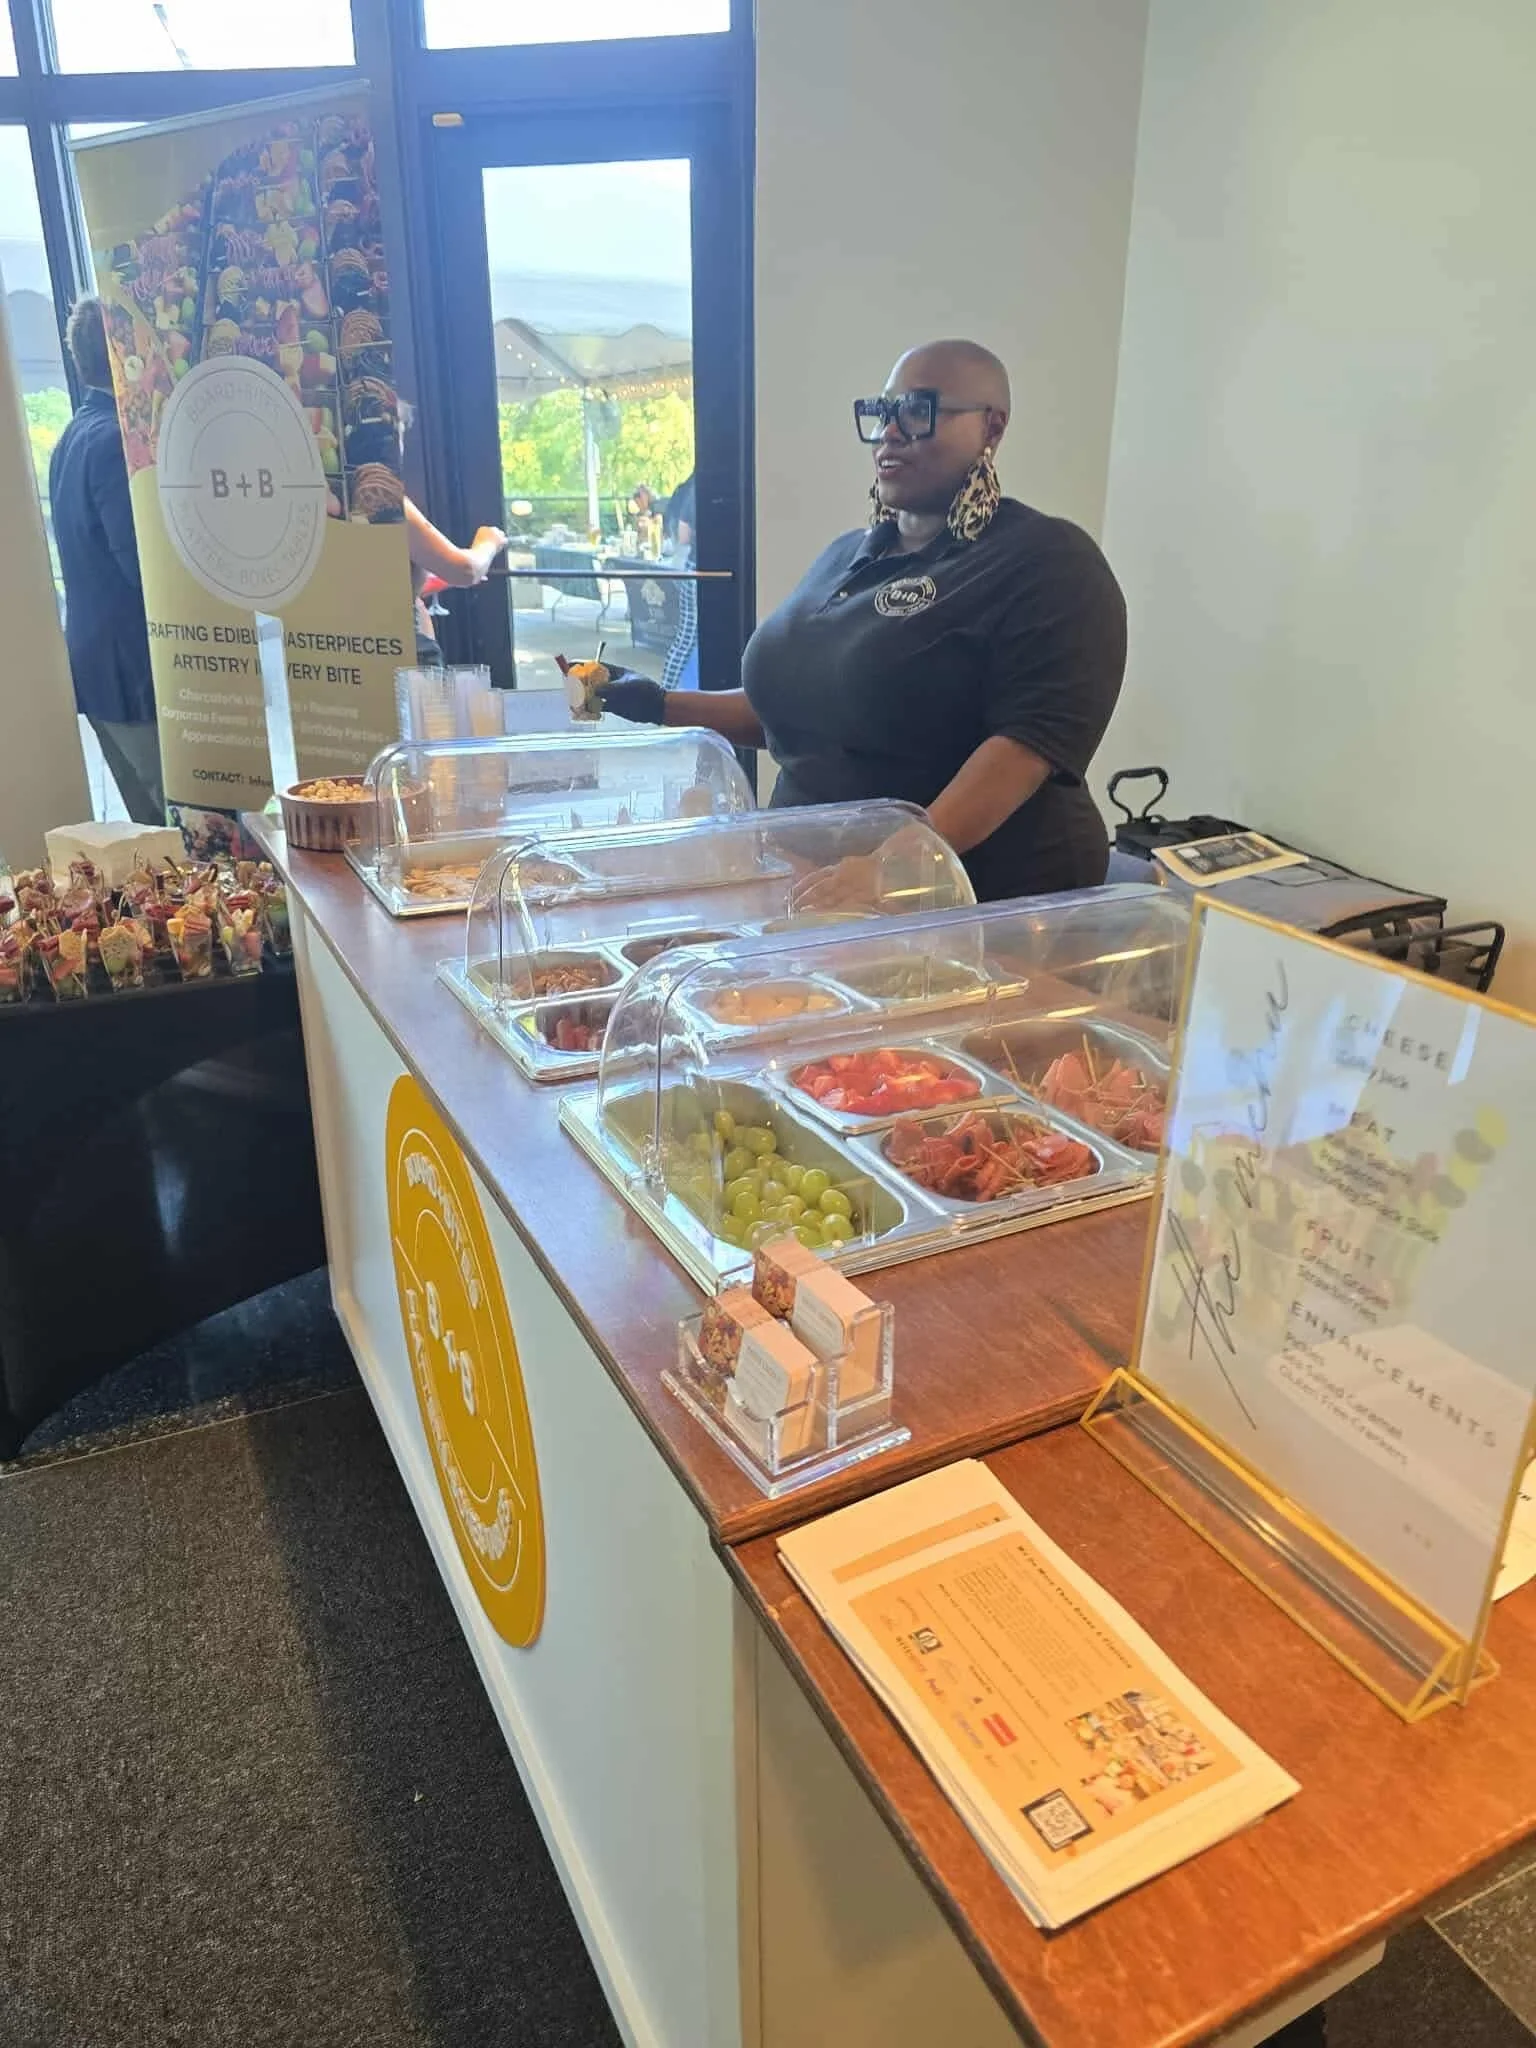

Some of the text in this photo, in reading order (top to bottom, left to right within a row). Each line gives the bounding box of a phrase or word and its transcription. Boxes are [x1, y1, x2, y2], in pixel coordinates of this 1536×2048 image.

[149, 621, 403, 656] RAFTING EDIBL ASTERPIECES
[173, 653, 249, 674] ARTISTRY
[326, 665, 363, 685] BITE
[1343, 1013, 1448, 1071] CHEESE
[1305, 1219, 1376, 1269] FRUIT
[1289, 1300, 1497, 1448] ENHANCEMENTS
